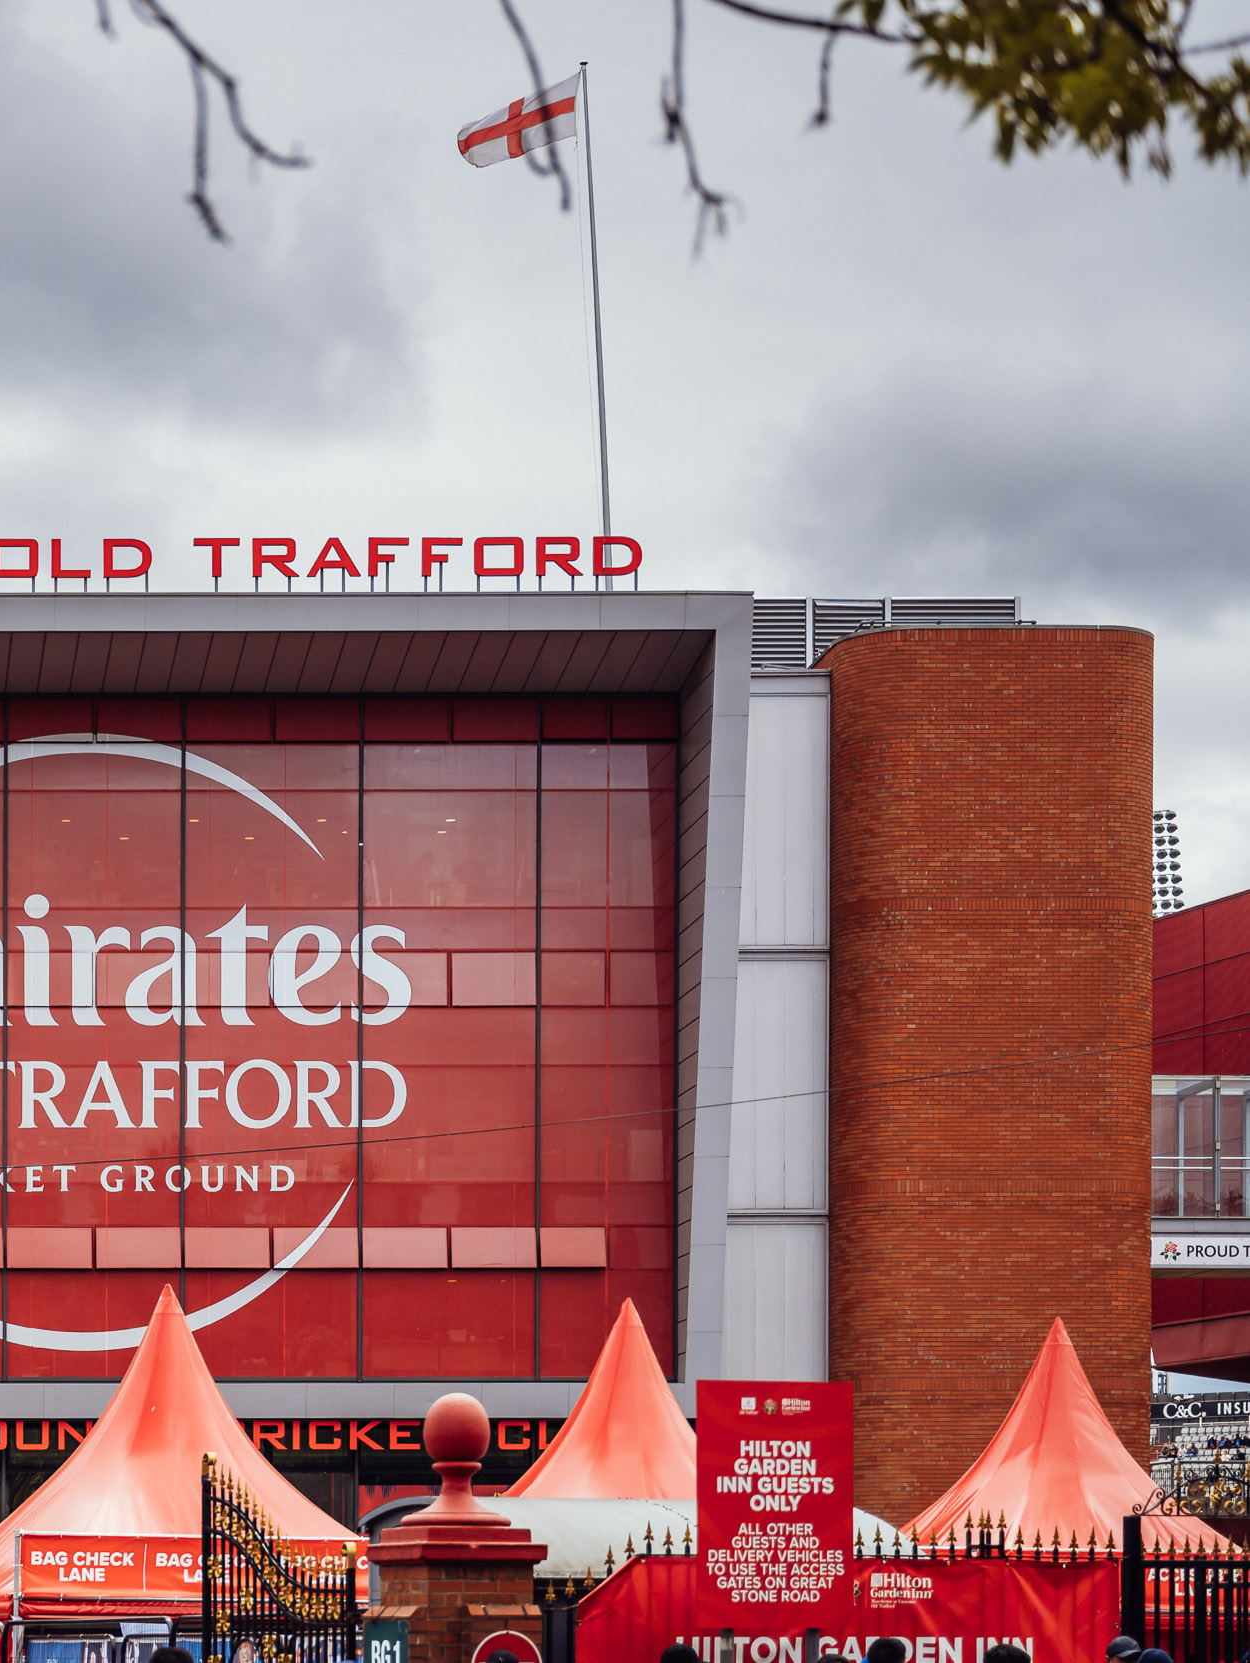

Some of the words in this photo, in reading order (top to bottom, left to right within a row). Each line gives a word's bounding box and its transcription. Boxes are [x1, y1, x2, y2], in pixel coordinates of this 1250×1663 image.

[193, 536, 643, 578] TRAFFORD
[99, 1164, 296, 1193] GROUND
[1186, 1245, 1239, 1258] PROUD
[240, 1420, 421, 1450] RICKE
[497, 1420, 552, 1450] CL
[740, 1440, 811, 1458] HILTON
[733, 1458, 817, 1476] GARDEN
[716, 1476, 752, 1494] INN
[757, 1476, 835, 1494] GUESTS
[749, 1494, 802, 1512] ONLY
[737, 1523, 763, 1535] ALL
[766, 1523, 814, 1536] OTHER
[731, 1536, 786, 1549] GUESTS
[789, 1536, 820, 1549] AND
[30, 1551, 68, 1565] BAG
[73, 1552, 135, 1567] CHECK
[155, 1552, 193, 1567] BAG
[707, 1550, 774, 1562] DELIVERY
[777, 1550, 844, 1563] VEHICLES
[59, 1567, 106, 1582] LANE
[183, 1569, 230, 1583] LAE
[706, 1563, 726, 1576] TO
[729, 1563, 757, 1576] USE
[759, 1563, 787, 1576] THE
[790, 1563, 845, 1576] ACCESS
[716, 1576, 762, 1589] GATES
[764, 1576, 786, 1589] ON
[789, 1576, 835, 1589] GREAT
[883, 1572, 932, 1588] Hilton
[731, 1590, 778, 1603] STONE
[781, 1590, 821, 1603] ROAD
[870, 1588, 911, 1598] Garden
[911, 1588, 932, 1599] Inn
